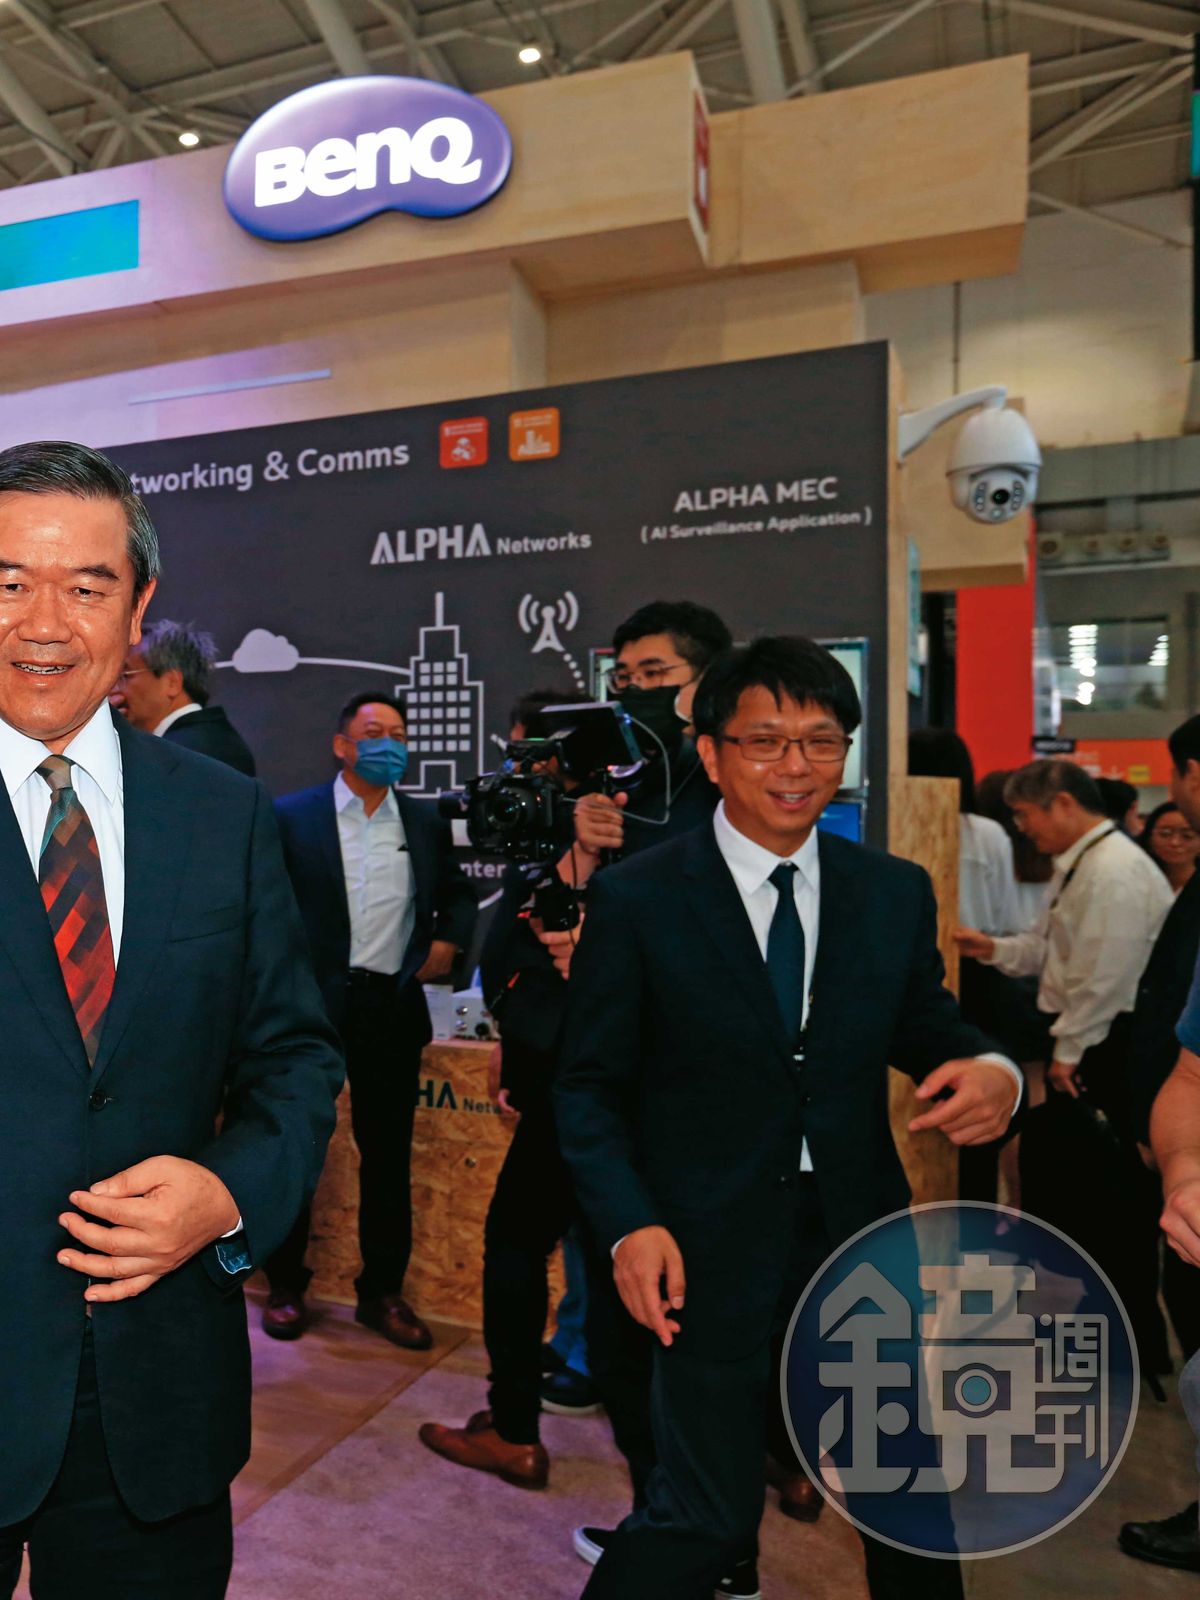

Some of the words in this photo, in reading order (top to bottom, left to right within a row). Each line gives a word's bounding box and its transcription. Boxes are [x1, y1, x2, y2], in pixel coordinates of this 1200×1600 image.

[254, 117, 483, 208] BenQ
[130, 463, 253, 494] tworking
[263, 451, 290, 482] &
[297, 444, 410, 477] Comms
[674, 483, 769, 513] ALPHA
[776, 476, 838, 504] MEC
[370, 523, 492, 565] ALPHA
[497, 531, 593, 555] Networks
[670, 519, 765, 539] Surveillance
[767, 510, 862, 533] Application
[459, 858, 507, 878] nter
